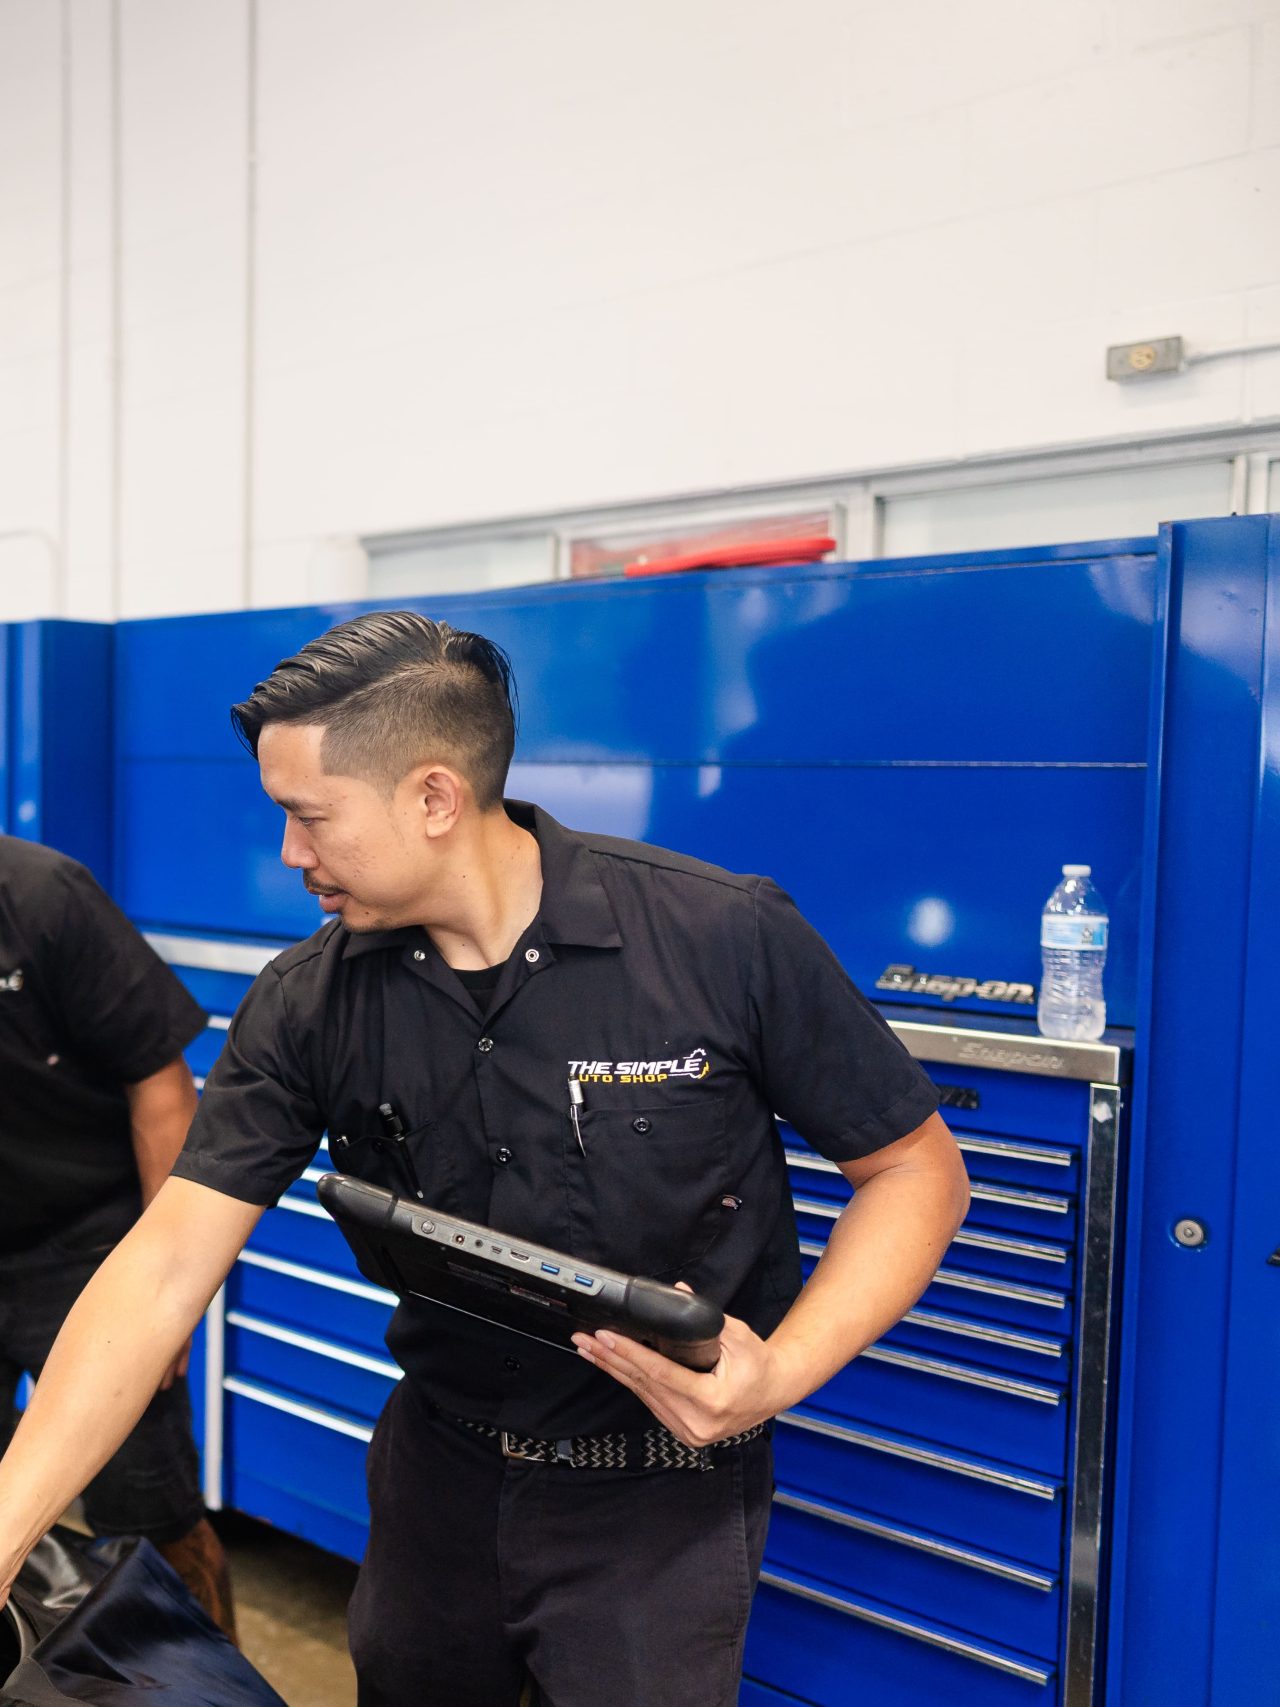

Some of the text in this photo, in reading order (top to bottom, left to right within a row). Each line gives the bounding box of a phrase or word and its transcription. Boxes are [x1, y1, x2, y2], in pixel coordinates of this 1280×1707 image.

[568, 1059, 703, 1076] THE SIMPLE
[577, 1074, 668, 1083] UTO SHOP
